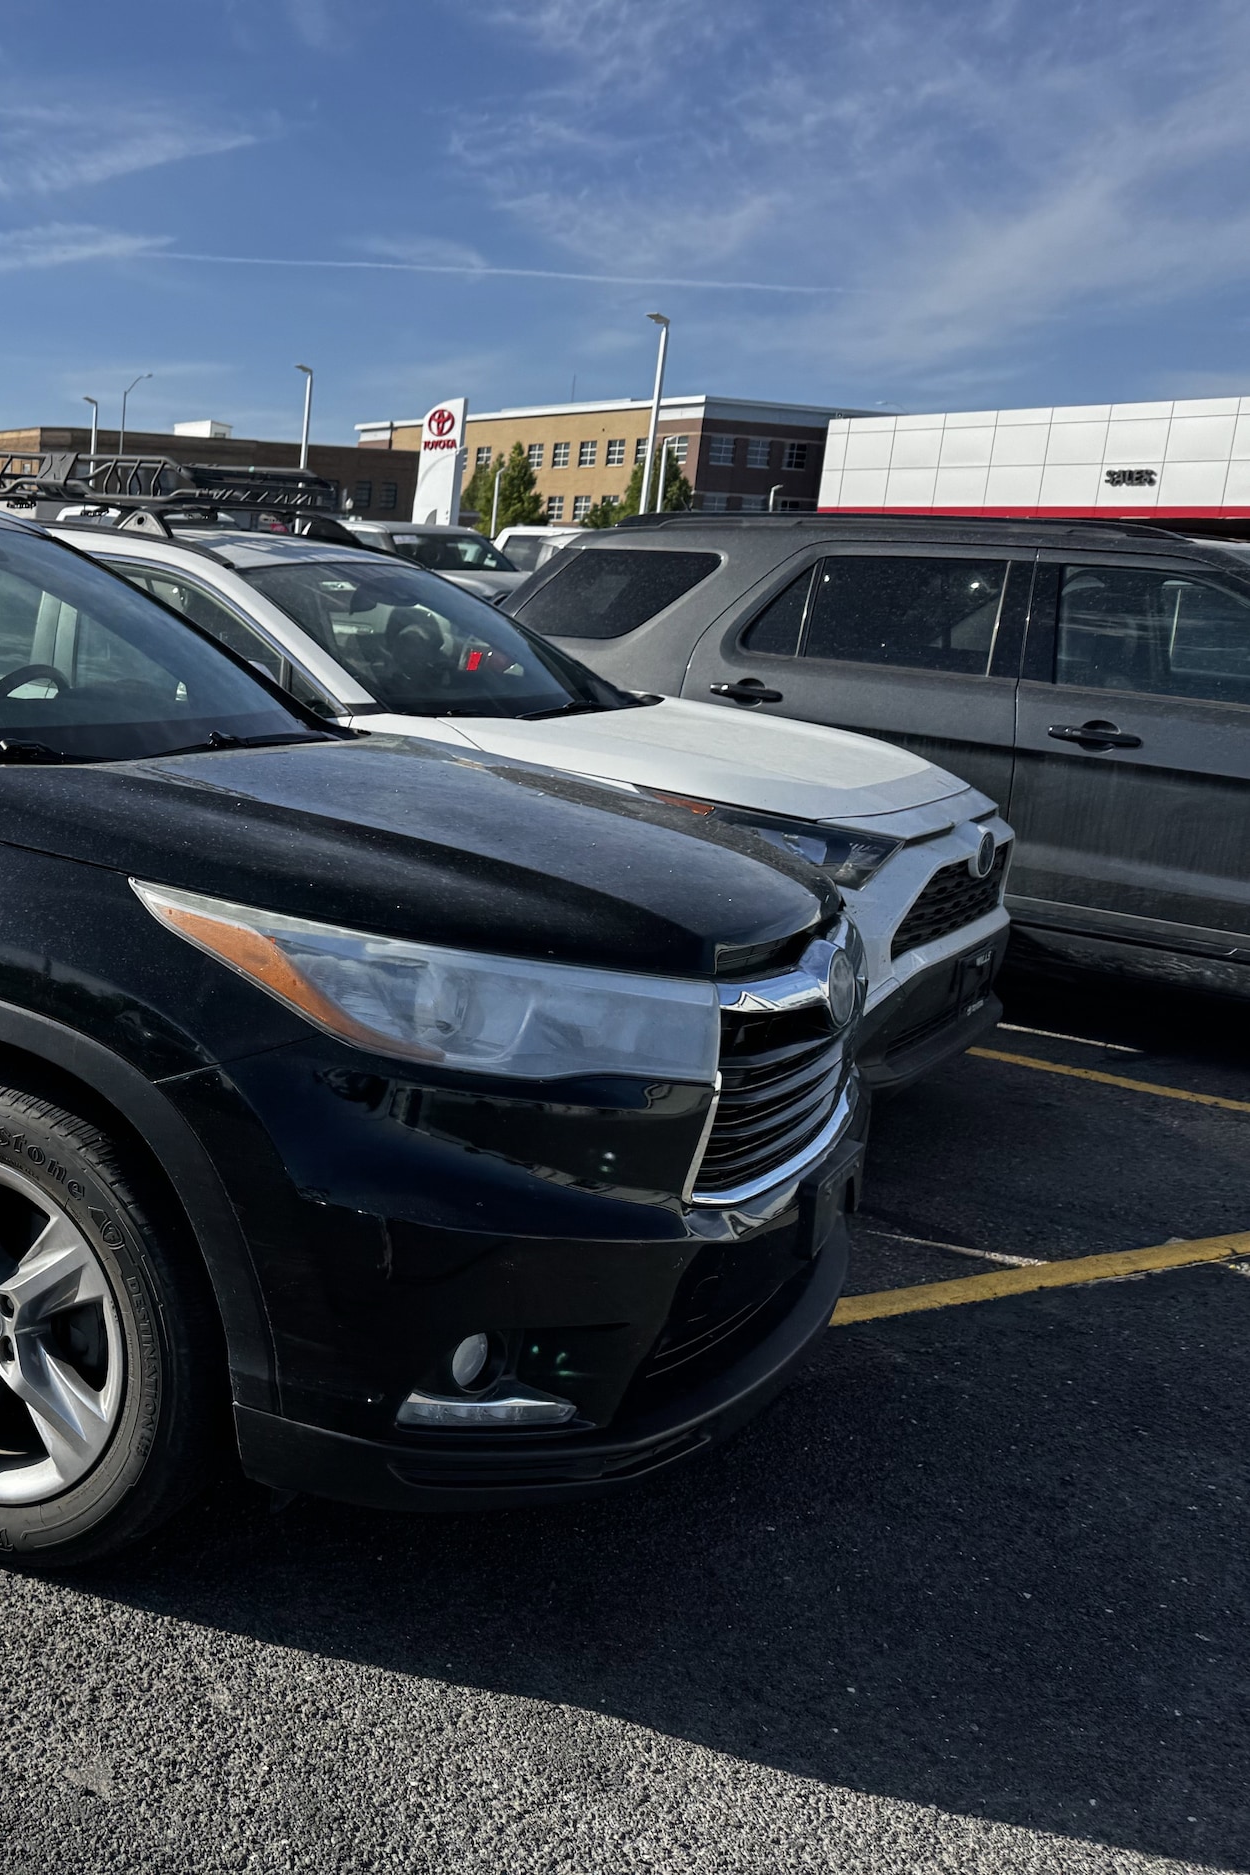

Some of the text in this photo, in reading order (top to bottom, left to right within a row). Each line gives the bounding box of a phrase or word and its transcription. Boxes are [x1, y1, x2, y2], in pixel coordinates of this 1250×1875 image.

[424, 438, 457, 451] TOYOTA
[1104, 469, 1158, 487] SALES
[126, 1275, 159, 1433] DESTINATION
